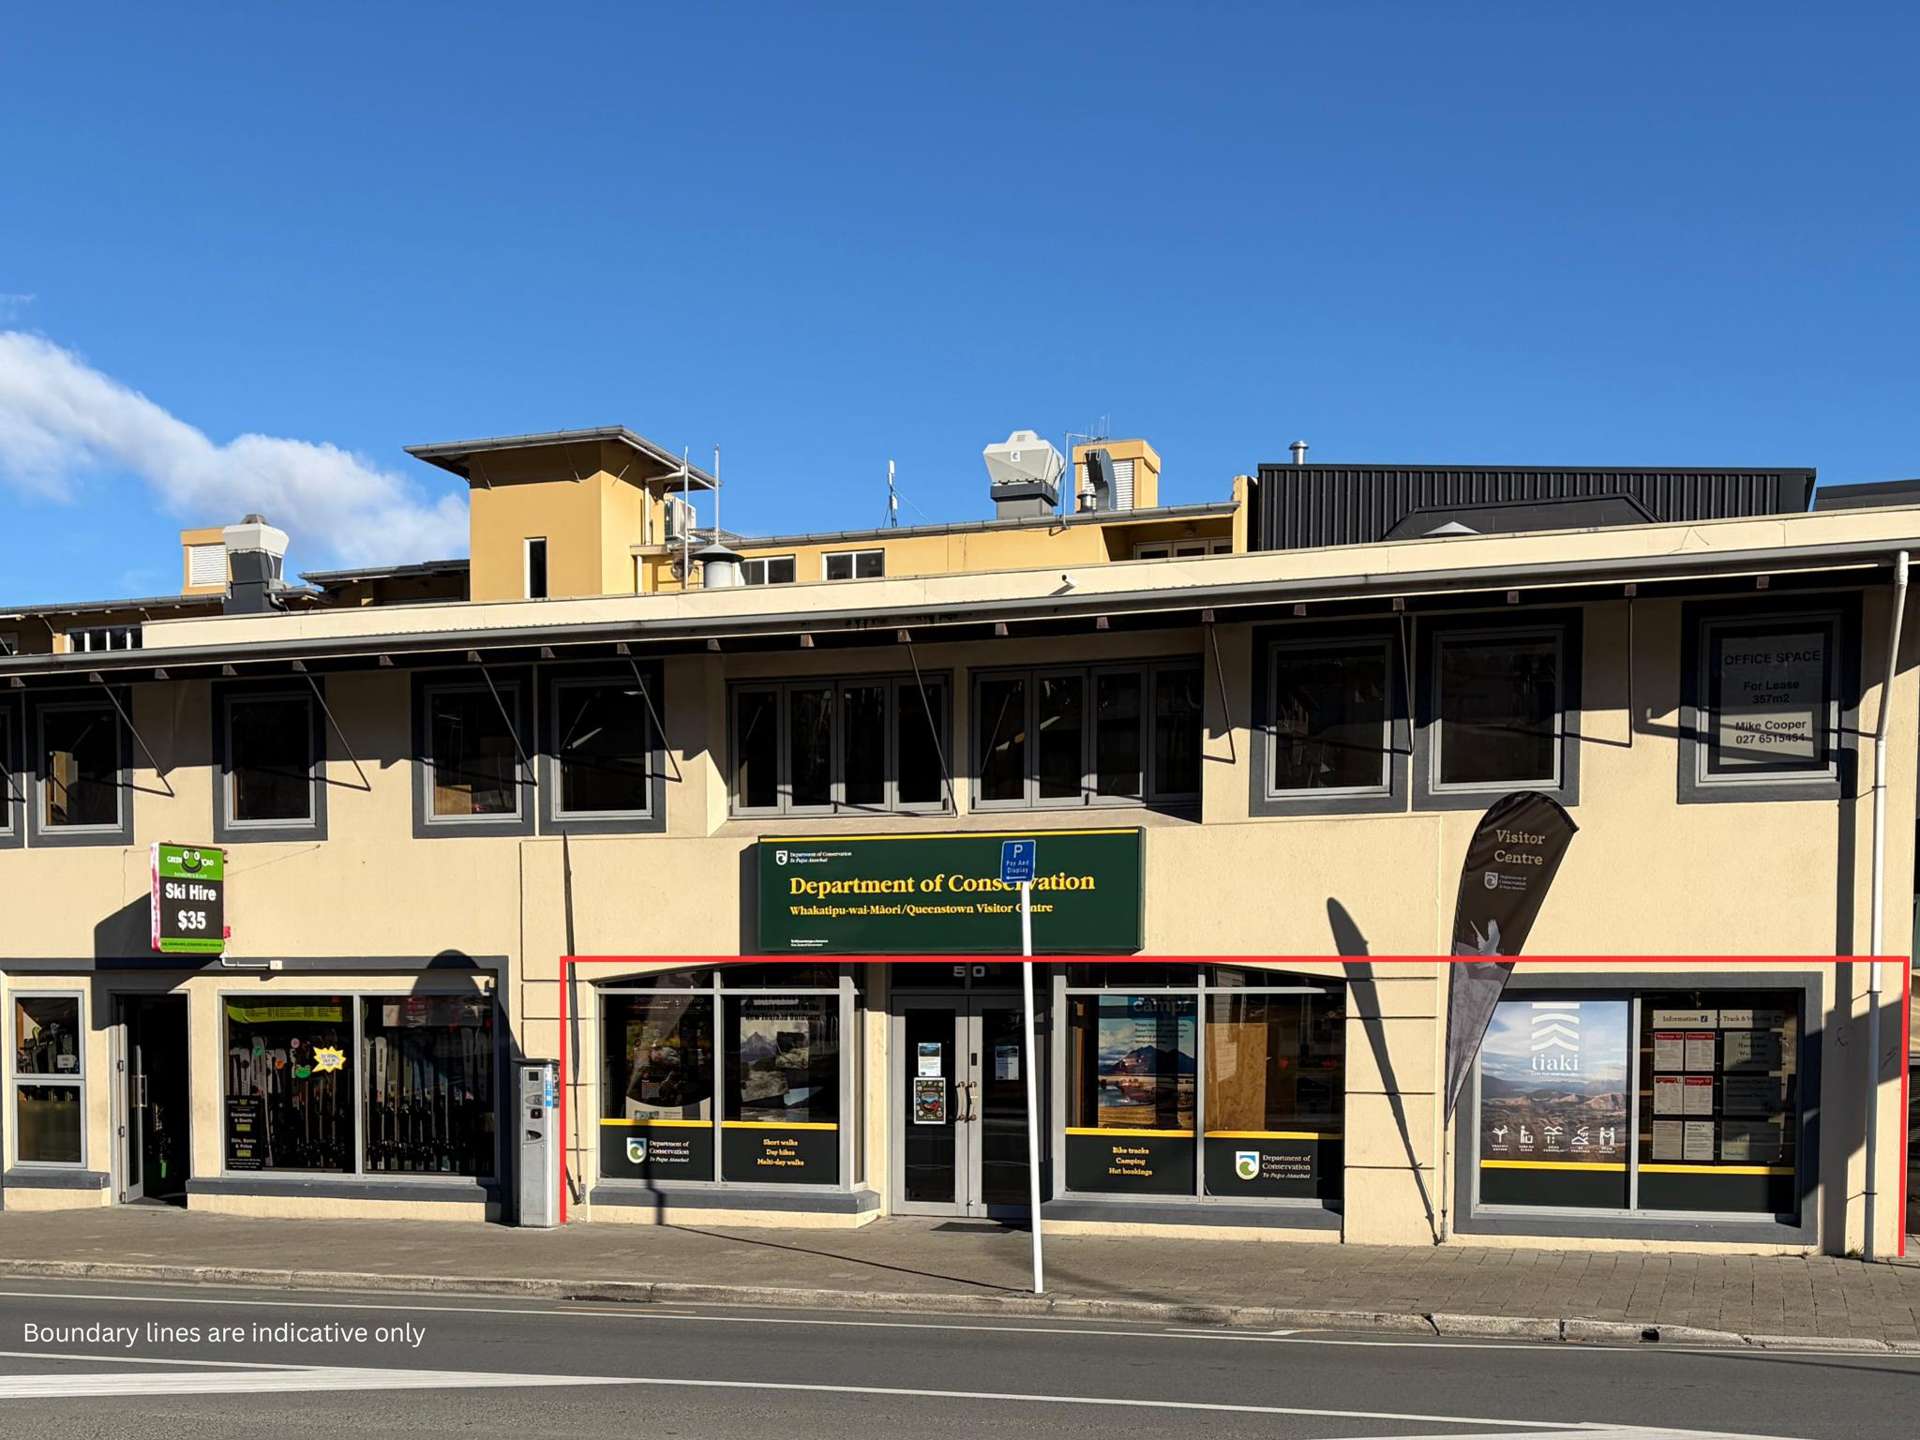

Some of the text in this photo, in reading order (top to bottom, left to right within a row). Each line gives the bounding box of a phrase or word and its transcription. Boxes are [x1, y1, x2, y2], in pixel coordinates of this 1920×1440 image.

[1724, 649, 1821, 666] OFFICE SPACE
[1743, 680, 1800, 691] For Lease
[1752, 694, 1790, 704] 357m2
[1735, 720, 1807, 731] Mike Cooper
[1735, 734, 1756, 744] 027
[1496, 829, 1546, 845] Visitor
[1013, 844, 1023, 858] P
[1494, 850, 1544, 865] Centre
[1007, 867, 1028, 875] Display
[790, 876, 915, 899] Department
[920, 873, 945, 892] of
[165, 882, 217, 901] Ski Hire
[976, 903, 1013, 913] Visitor
[1015, 903, 1053, 913] Cntre
[178, 910, 206, 930] $35
[953, 965, 986, 977] 50
[1532, 1053, 1579, 1071] tiaki
[650, 1140, 682, 1148] Department
[763, 1138, 780, 1146] Short
[779, 1148, 795, 1156] hikes
[1112, 1146, 1127, 1154] Bike
[1115, 1157, 1146, 1166] Camping
[1262, 1154, 1301, 1162] Department
[1262, 1162, 1311, 1170] Conservation
[1122, 1167, 1153, 1176] bookings
